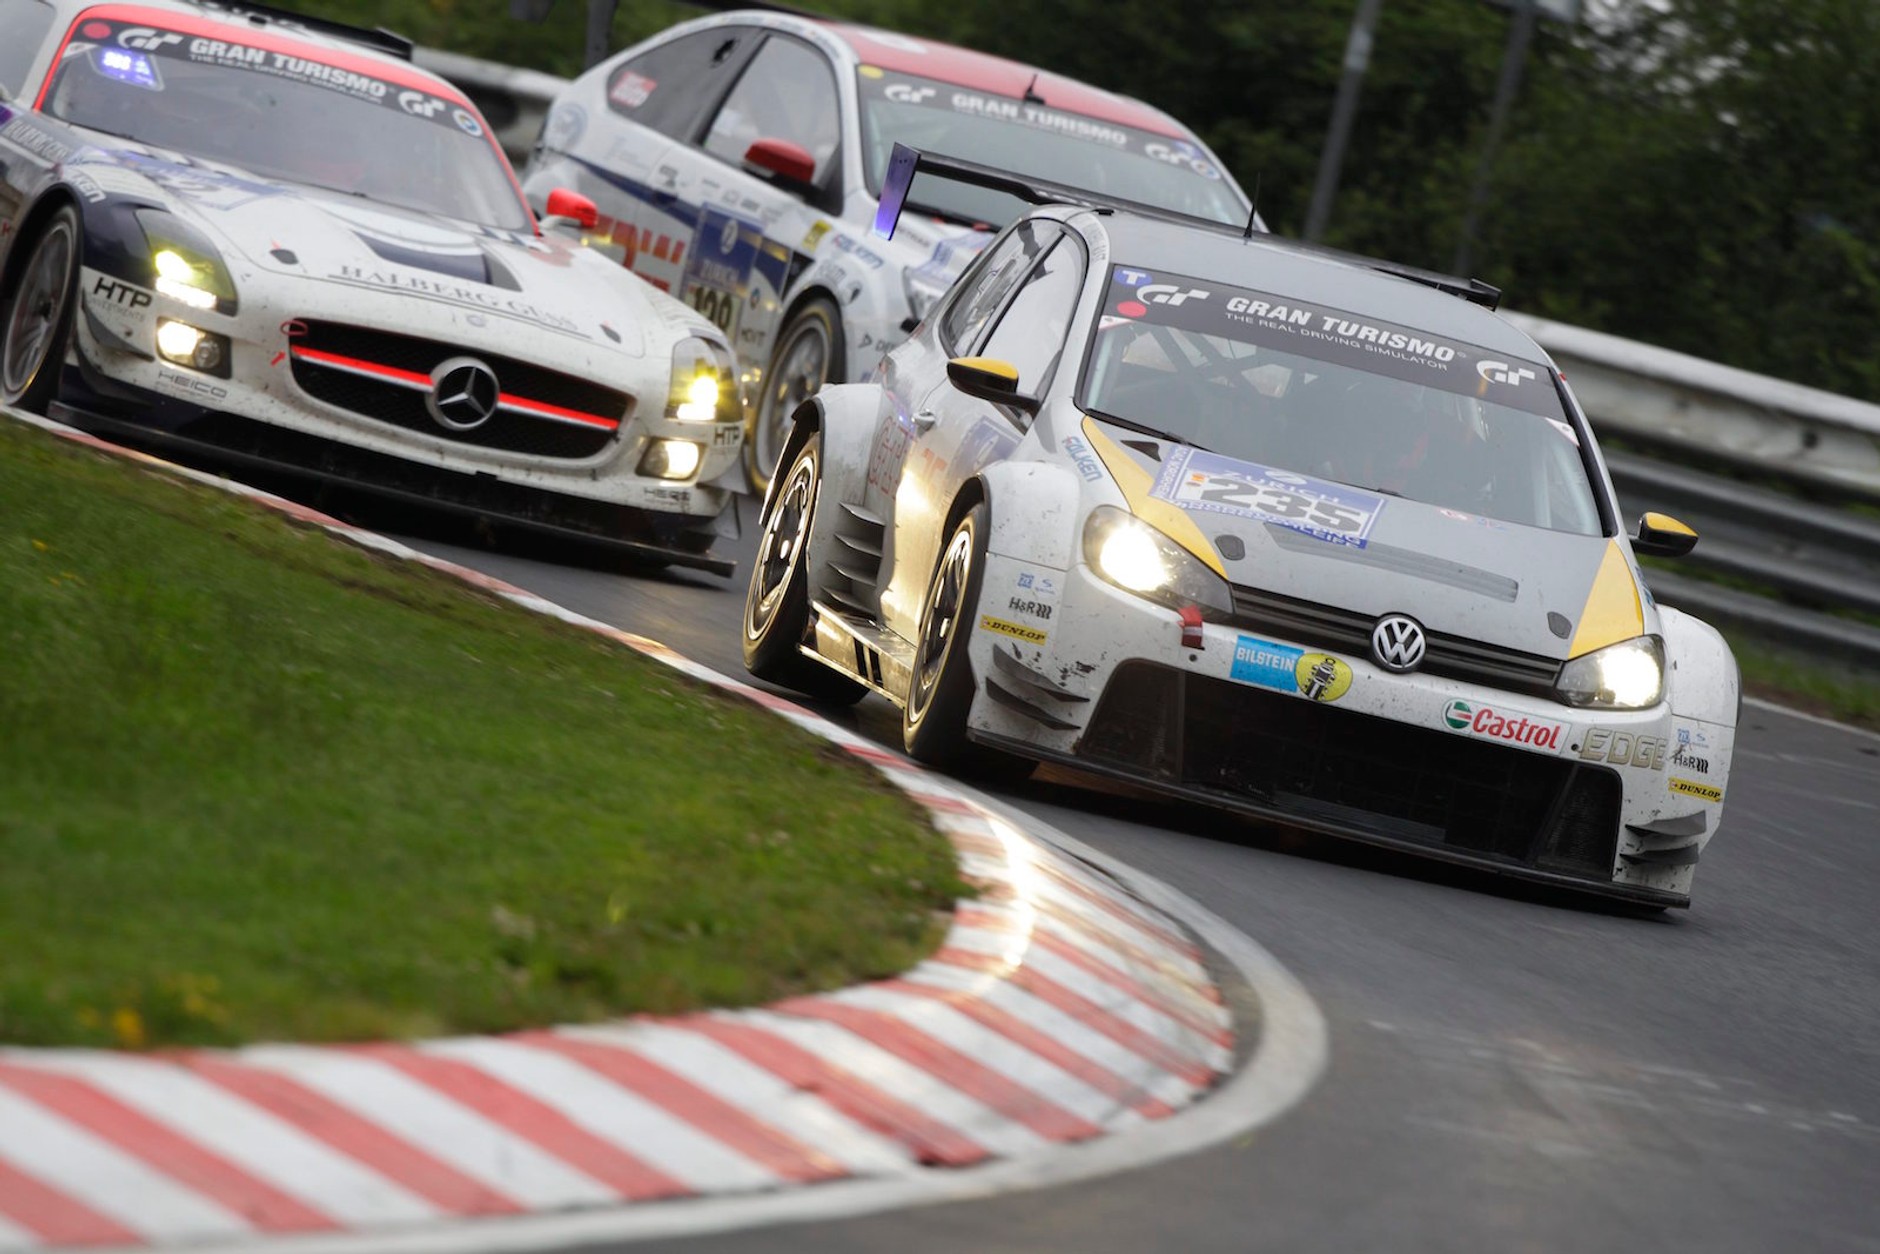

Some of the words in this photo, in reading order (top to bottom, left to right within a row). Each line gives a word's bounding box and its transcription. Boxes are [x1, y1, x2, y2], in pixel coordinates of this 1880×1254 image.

[189, 37, 266, 64] GRAN
[272, 52, 387, 98] TURISMO
[952, 93, 1018, 118] GRAN
[1023, 108, 1127, 145] TURISMO
[93, 276, 152, 308] HTP
[340, 265, 498, 306] HALBERG
[1122, 270, 1147, 285] T
[1225, 312, 1254, 325] THE
[1259, 319, 1297, 334] REAL
[1300, 328, 1361, 349] DRIVING
[1365, 344, 1448, 371] SIMULATOR
[1226, 297, 1312, 326] GRAN
[1322, 316, 1455, 362] TURISMO
[158, 370, 228, 399] HEICO
[714, 426, 741, 446] HTP
[1062, 436, 1103, 483] FALKEN
[1200, 478, 1361, 532] 235
[1223, 470, 1339, 503] ZURICH
[989, 622, 1045, 641] DUNLOP
[1236, 647, 1296, 673] BILSTEIN
[1472, 708, 1561, 750] Castrol
[1579, 727, 1669, 772] EDGE
[1679, 783, 1722, 799] DUNLOP
